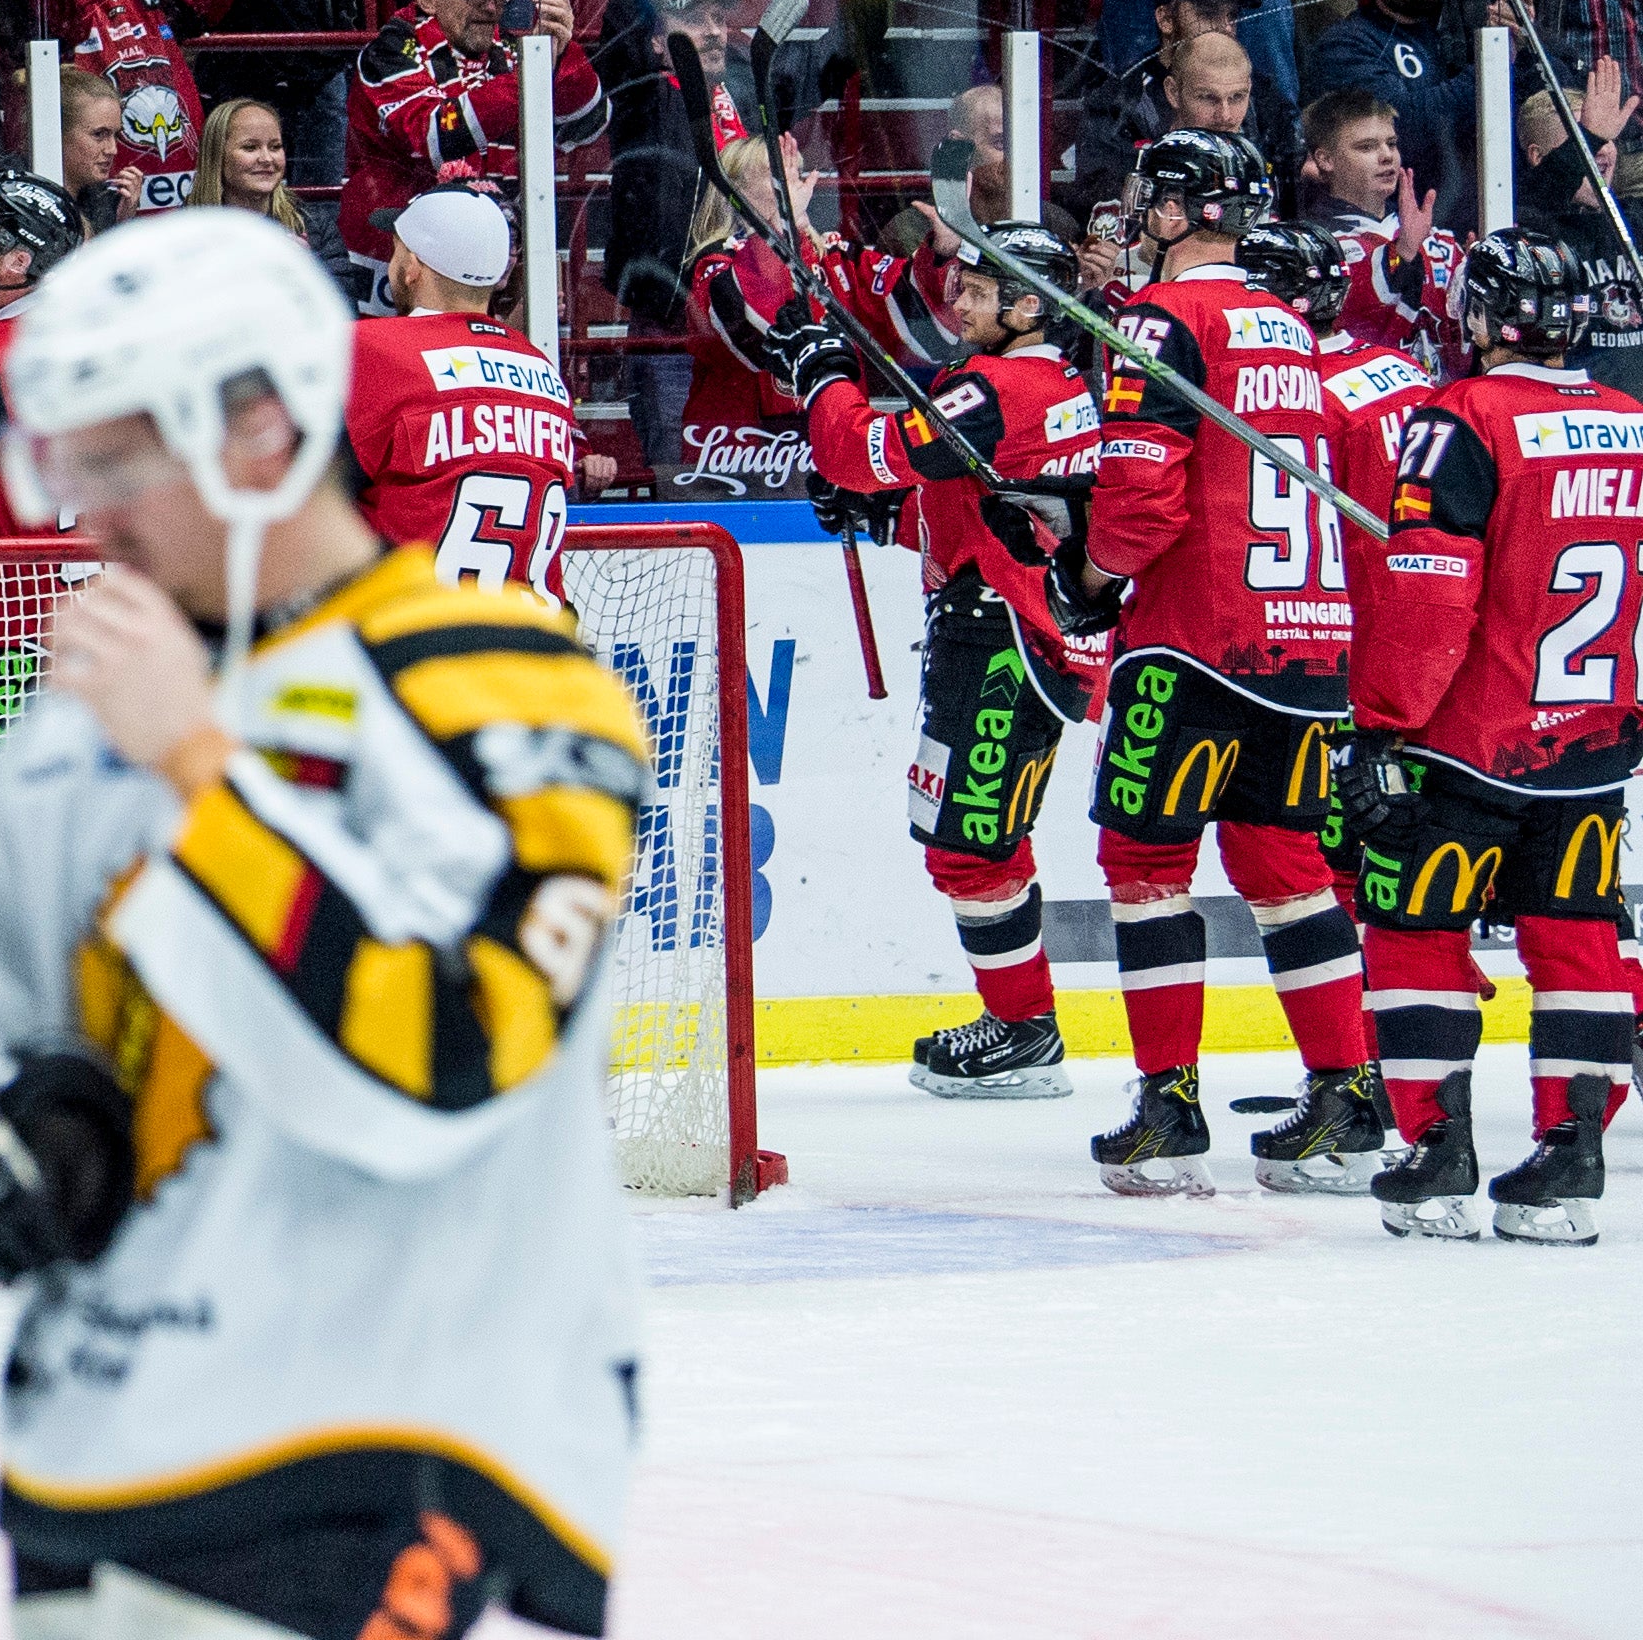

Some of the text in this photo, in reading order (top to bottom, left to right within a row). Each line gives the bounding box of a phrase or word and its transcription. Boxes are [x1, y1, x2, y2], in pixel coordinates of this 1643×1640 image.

[1394, 44, 1423, 78] 6
[1157, 170, 1185, 180] CCM
[18, 227, 46, 248] CCM
[473, 323, 505, 335] CCM
[1553, 304, 1565, 317] 21
[477, 351, 567, 402] bravida
[1558, 387, 1595, 396] CCM
[424, 405, 573, 472] ALSENFEL
[1399, 422, 1454, 478] 21
[1551, 467, 1643, 519] MIEL
[1534, 539, 1643, 705] 2
[1110, 664, 1178, 817] akea
[962, 707, 1014, 845] akea
[981, 1048, 1013, 1064] CCM
